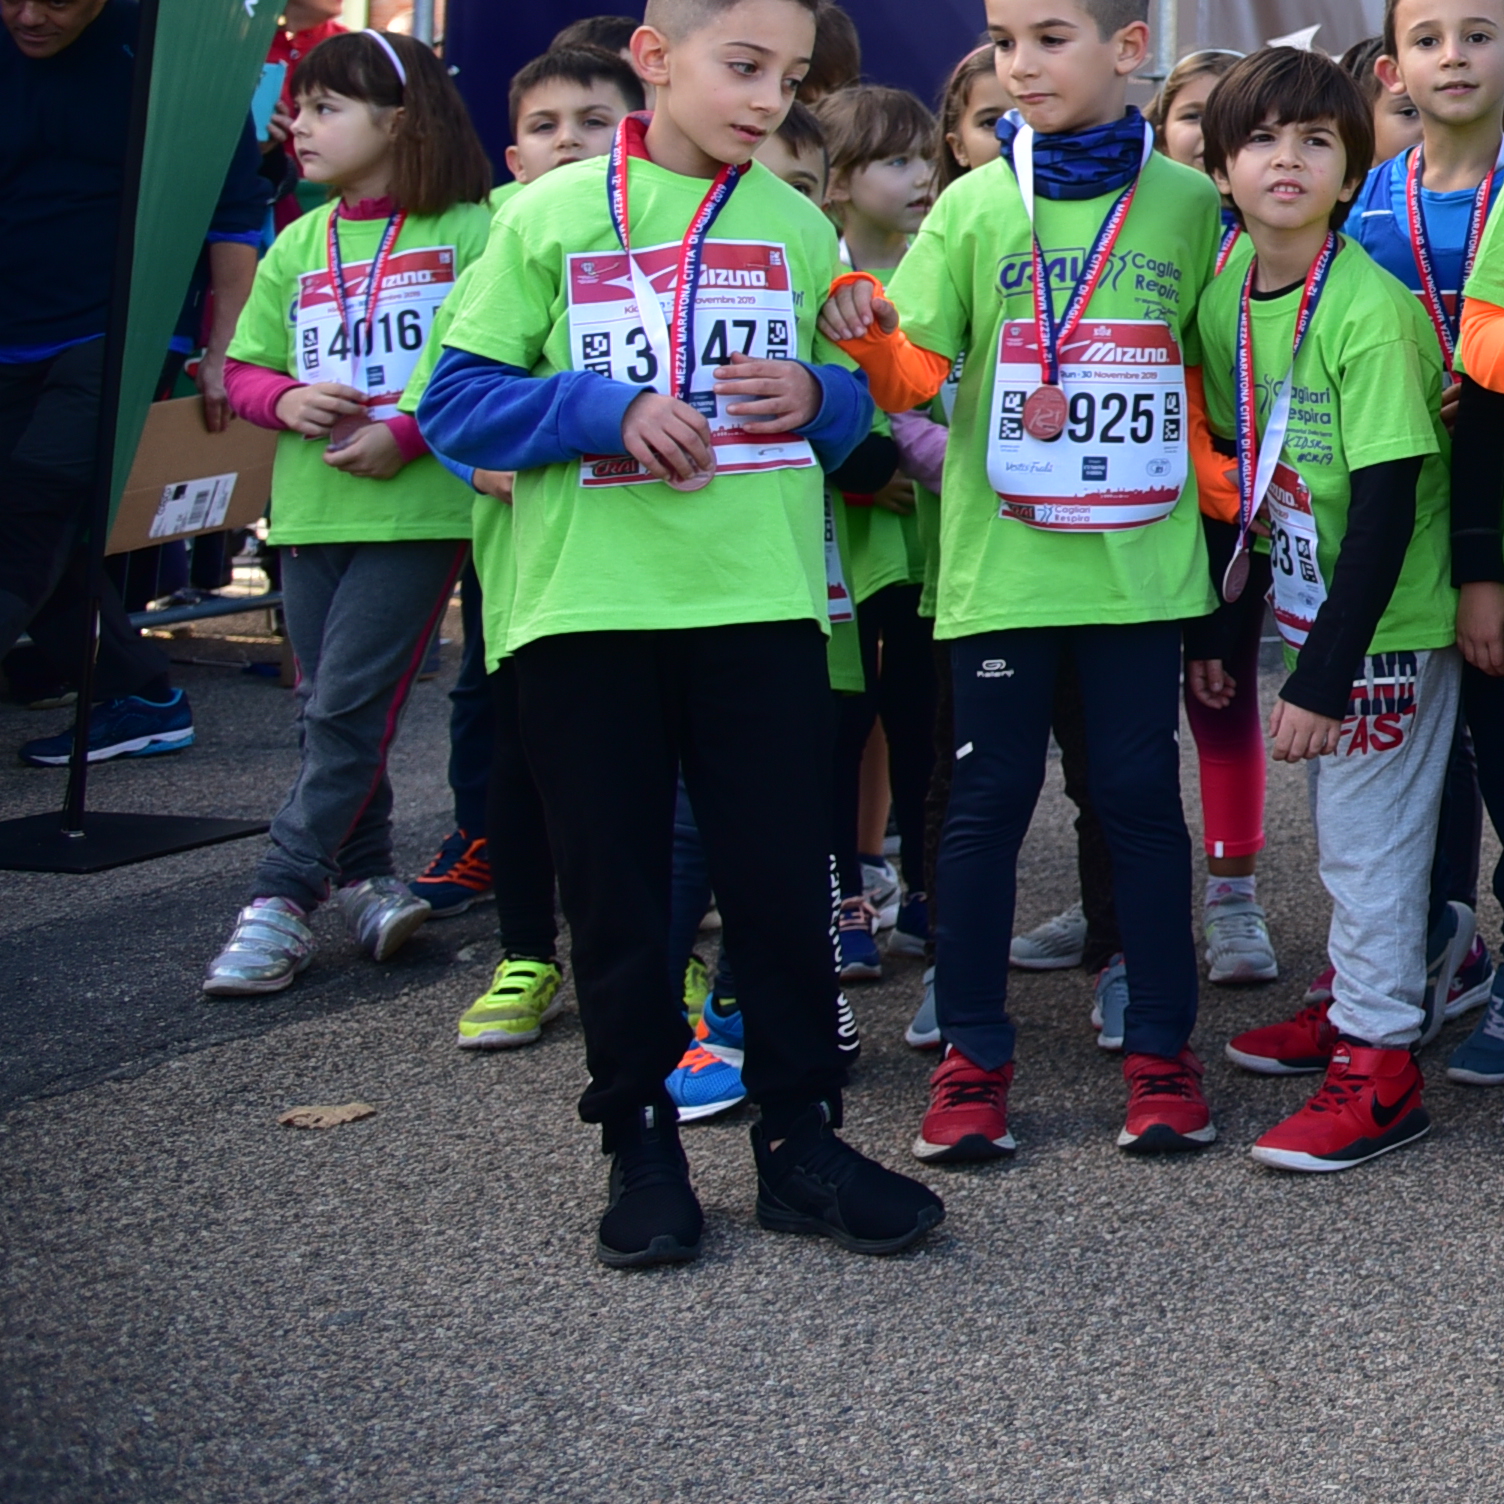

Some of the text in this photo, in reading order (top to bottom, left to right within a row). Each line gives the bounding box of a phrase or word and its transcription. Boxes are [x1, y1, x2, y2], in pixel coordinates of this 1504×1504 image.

[1467, 208, 1482, 259] MARATONA
[1313, 250, 1332, 282] MEZZA
[674, 183, 728, 385] MEZZA MARATONA DI 2019
[737, 295, 757, 304] 2019
[1035, 253, 1051, 347] MEZZA MARATONA
[1425, 274, 1446, 325] MARATONA
[327, 308, 423, 362] 4016
[1080, 342, 1168, 363] MIZUNO
[1094, 370, 1158, 380] Novembre 2019
[1239, 346, 1252, 499] MARATONA CAGLIARI
[592, 459, 638, 476] CRAI
[1054, 505, 1091, 515] Cagliari
[1054, 514, 1091, 523] Respira
